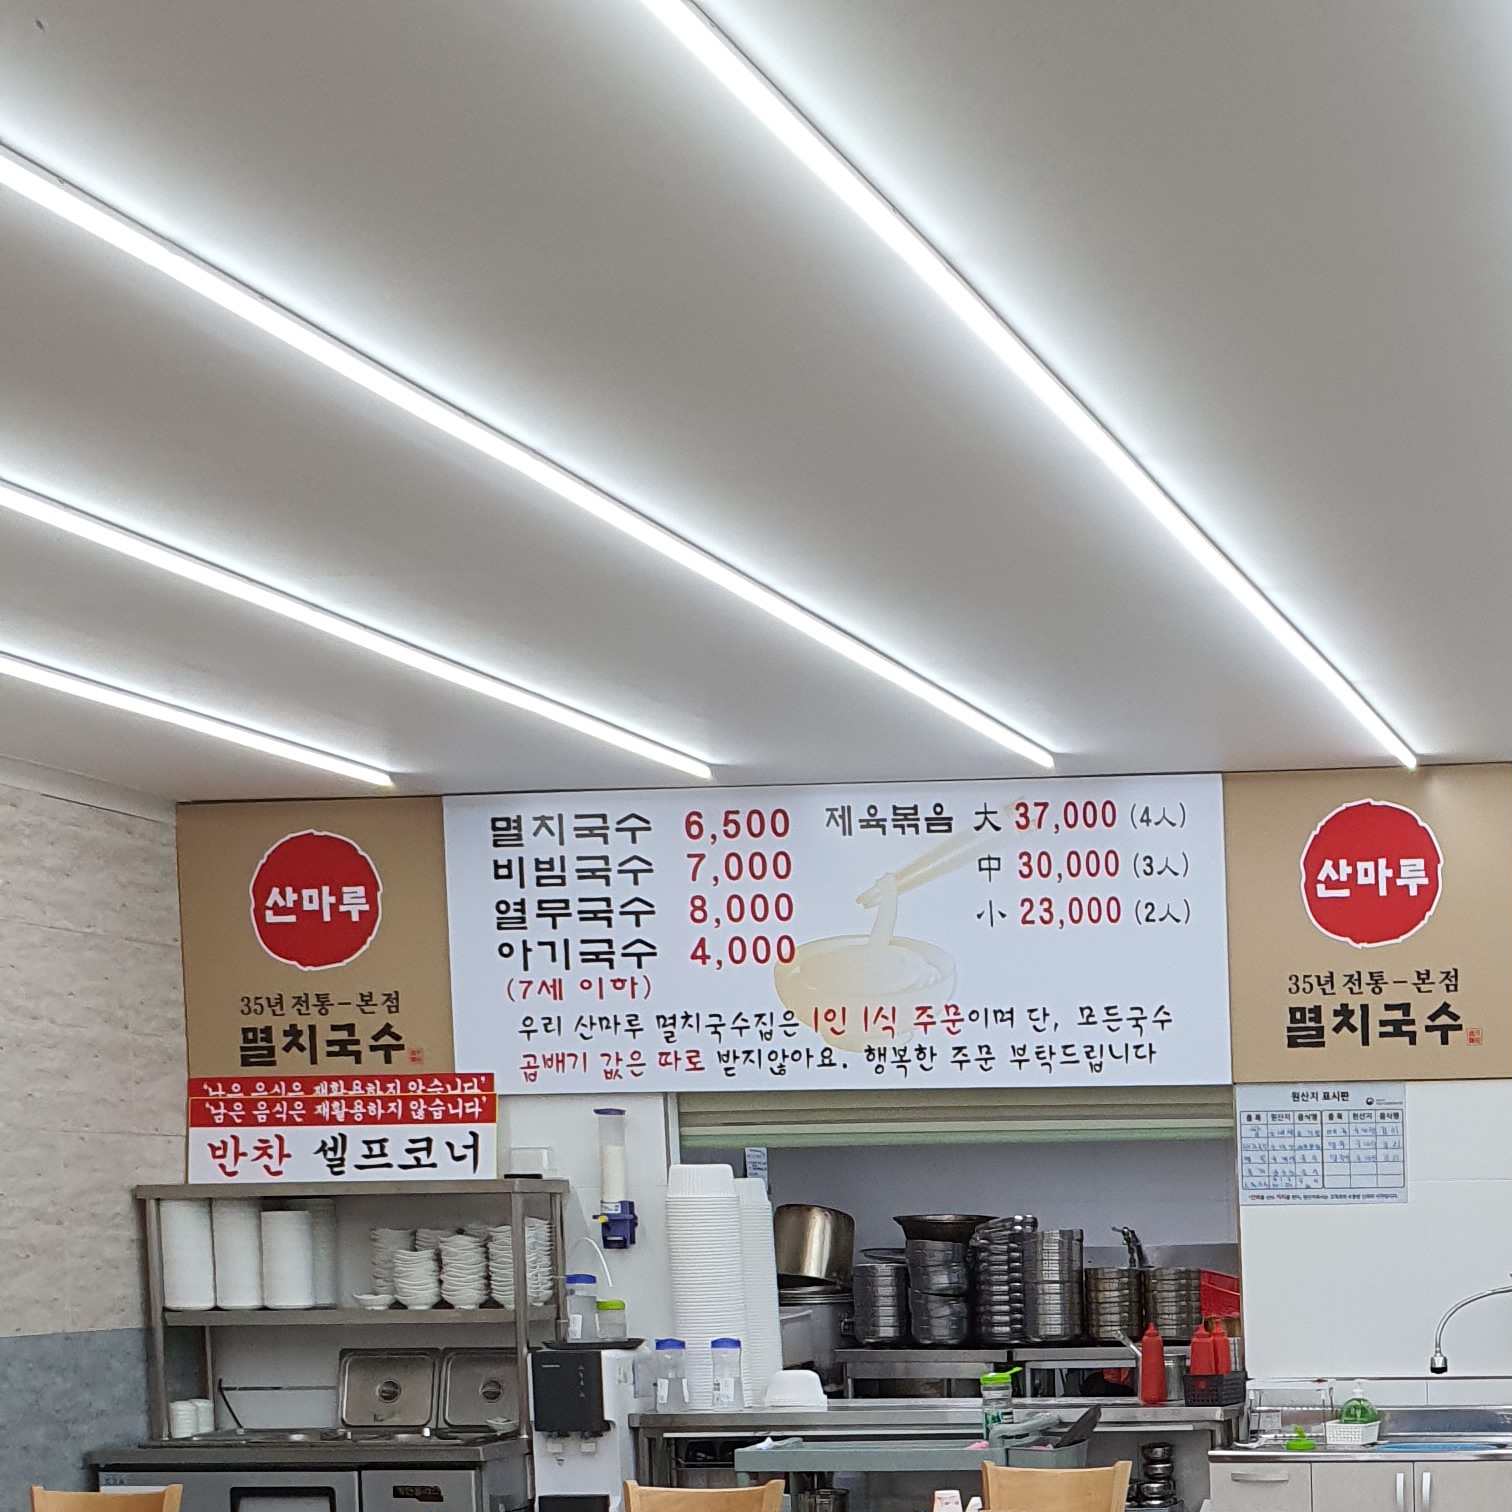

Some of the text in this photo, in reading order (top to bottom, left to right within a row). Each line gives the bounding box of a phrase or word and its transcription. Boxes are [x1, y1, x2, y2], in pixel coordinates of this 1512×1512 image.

[490, 808, 790, 848] 멸치국수 6,500
[825, 802, 955, 838] 제육볶음
[973, 802, 1003, 833] 大
[1014, 799, 1118, 835] 37,000
[493, 851, 792, 889] 비빔국수 7,000
[978, 854, 1001, 883] 中
[1018, 849, 1120, 883] 30,000
[1315, 857, 1430, 899] 산마루
[264, 885, 370, 925] 산마루
[495, 893, 794, 931] 열무국수 8,000
[976, 900, 1008, 927] 小
[1019, 896, 1122, 930] 23,000
[497, 934, 796, 971] 아기국수 4,000
[506, 976, 652, 1002] (7세 이하)
[1288, 971, 1337, 995] 35년
[240, 993, 285, 1016] 35년
[518, 1014, 562, 1041] 우리
[574, 1014, 644, 1041] 산마루
[656, 1010, 800, 1044] 멸치국수집은
[913, 1004, 1015, 1035] 주문이며
[1027, 1006, 1060, 1034] 단,
[1077, 1005, 1174, 1034] 모든국수
[1286, 1001, 1464, 1048] 멸치국수
[240, 1022, 405, 1067] 멸치국수
[519, 1042, 1158, 1082] 곱배기 값은 따로 받지않아요. 행복한 주문 부탁드립니다
[252, 1100, 306, 1123] 음식은
[314, 1097, 402, 1122] 재활용하지
[1291, 1091, 1350, 1102] 원산지 표시판
[207, 1131, 480, 1177] 반찬 셀프코너
